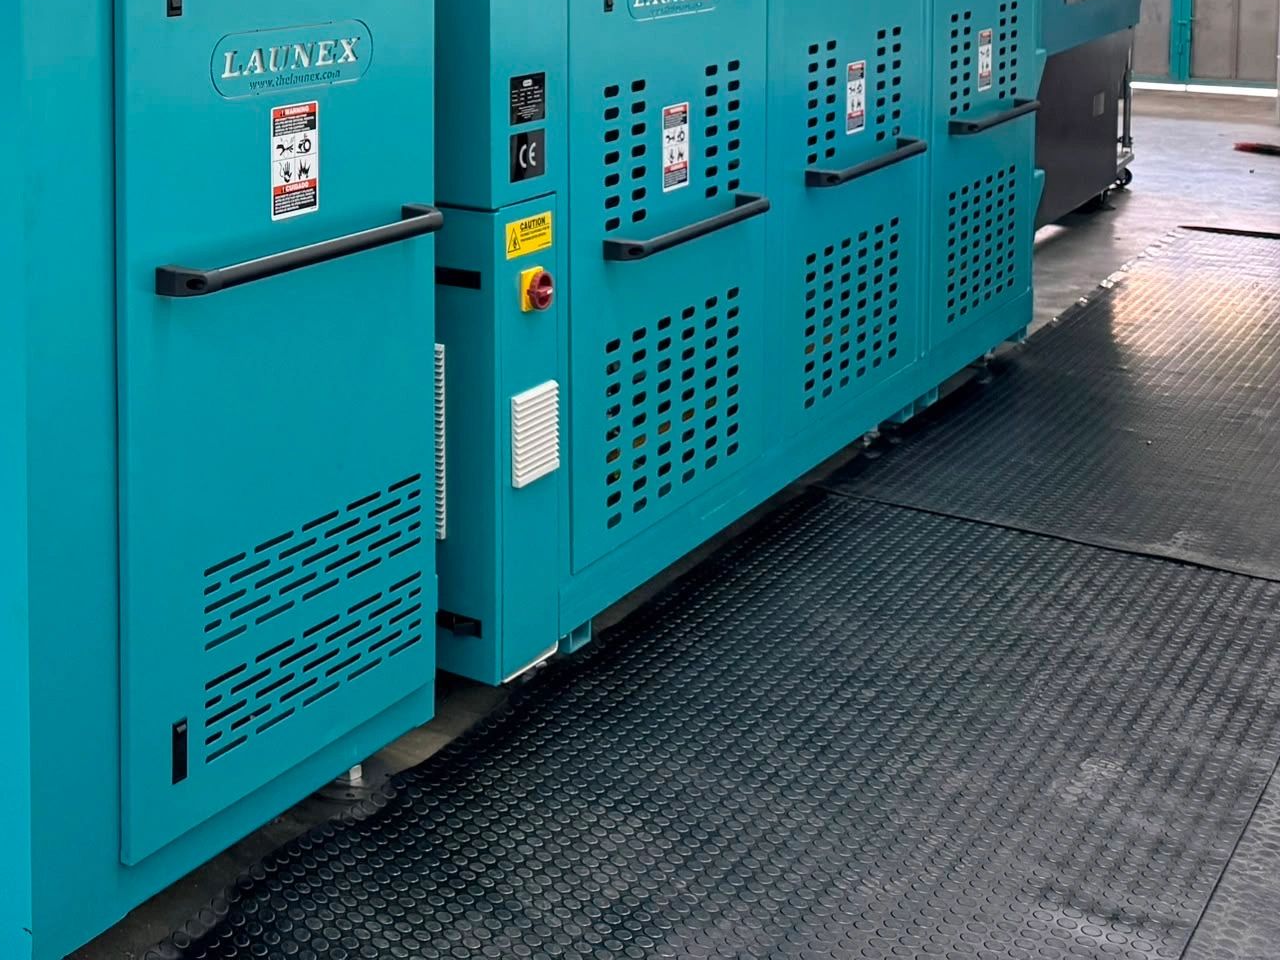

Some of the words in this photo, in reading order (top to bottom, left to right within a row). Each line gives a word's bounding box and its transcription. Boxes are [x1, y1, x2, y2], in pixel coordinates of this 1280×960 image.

[221, 37, 360, 78] LAUNEX
[249, 70, 341, 90] www.thelaunex.com
[519, 142, 536, 168] CE
[520, 216, 546, 231] CAUTION
